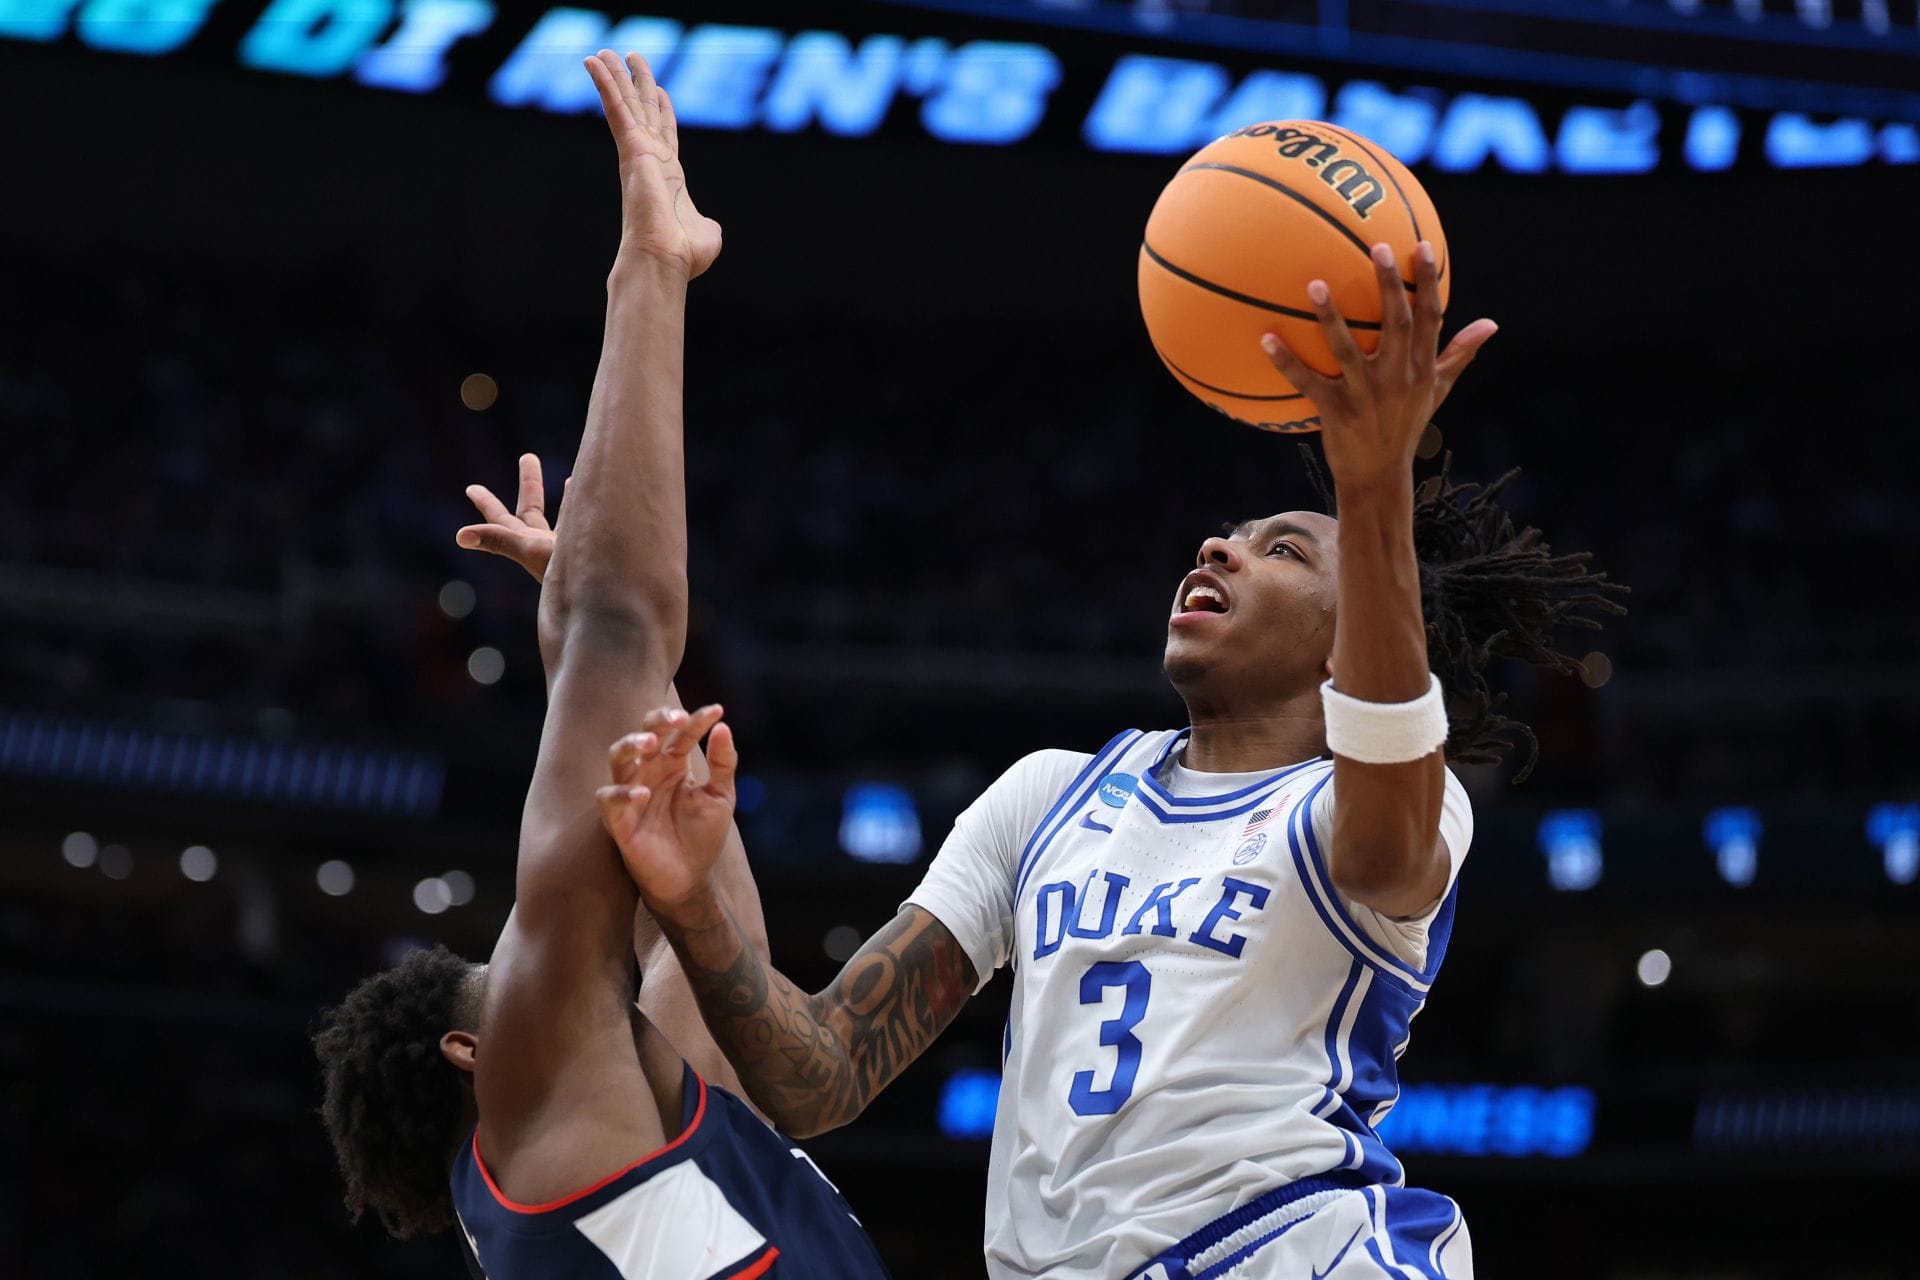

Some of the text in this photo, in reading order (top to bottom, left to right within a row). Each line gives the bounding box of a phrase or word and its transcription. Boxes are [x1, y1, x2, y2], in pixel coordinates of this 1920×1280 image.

[1230, 124, 1387, 221] Wilso
[1034, 868, 1272, 960] DUKE
[1068, 960, 1152, 1117] 3
